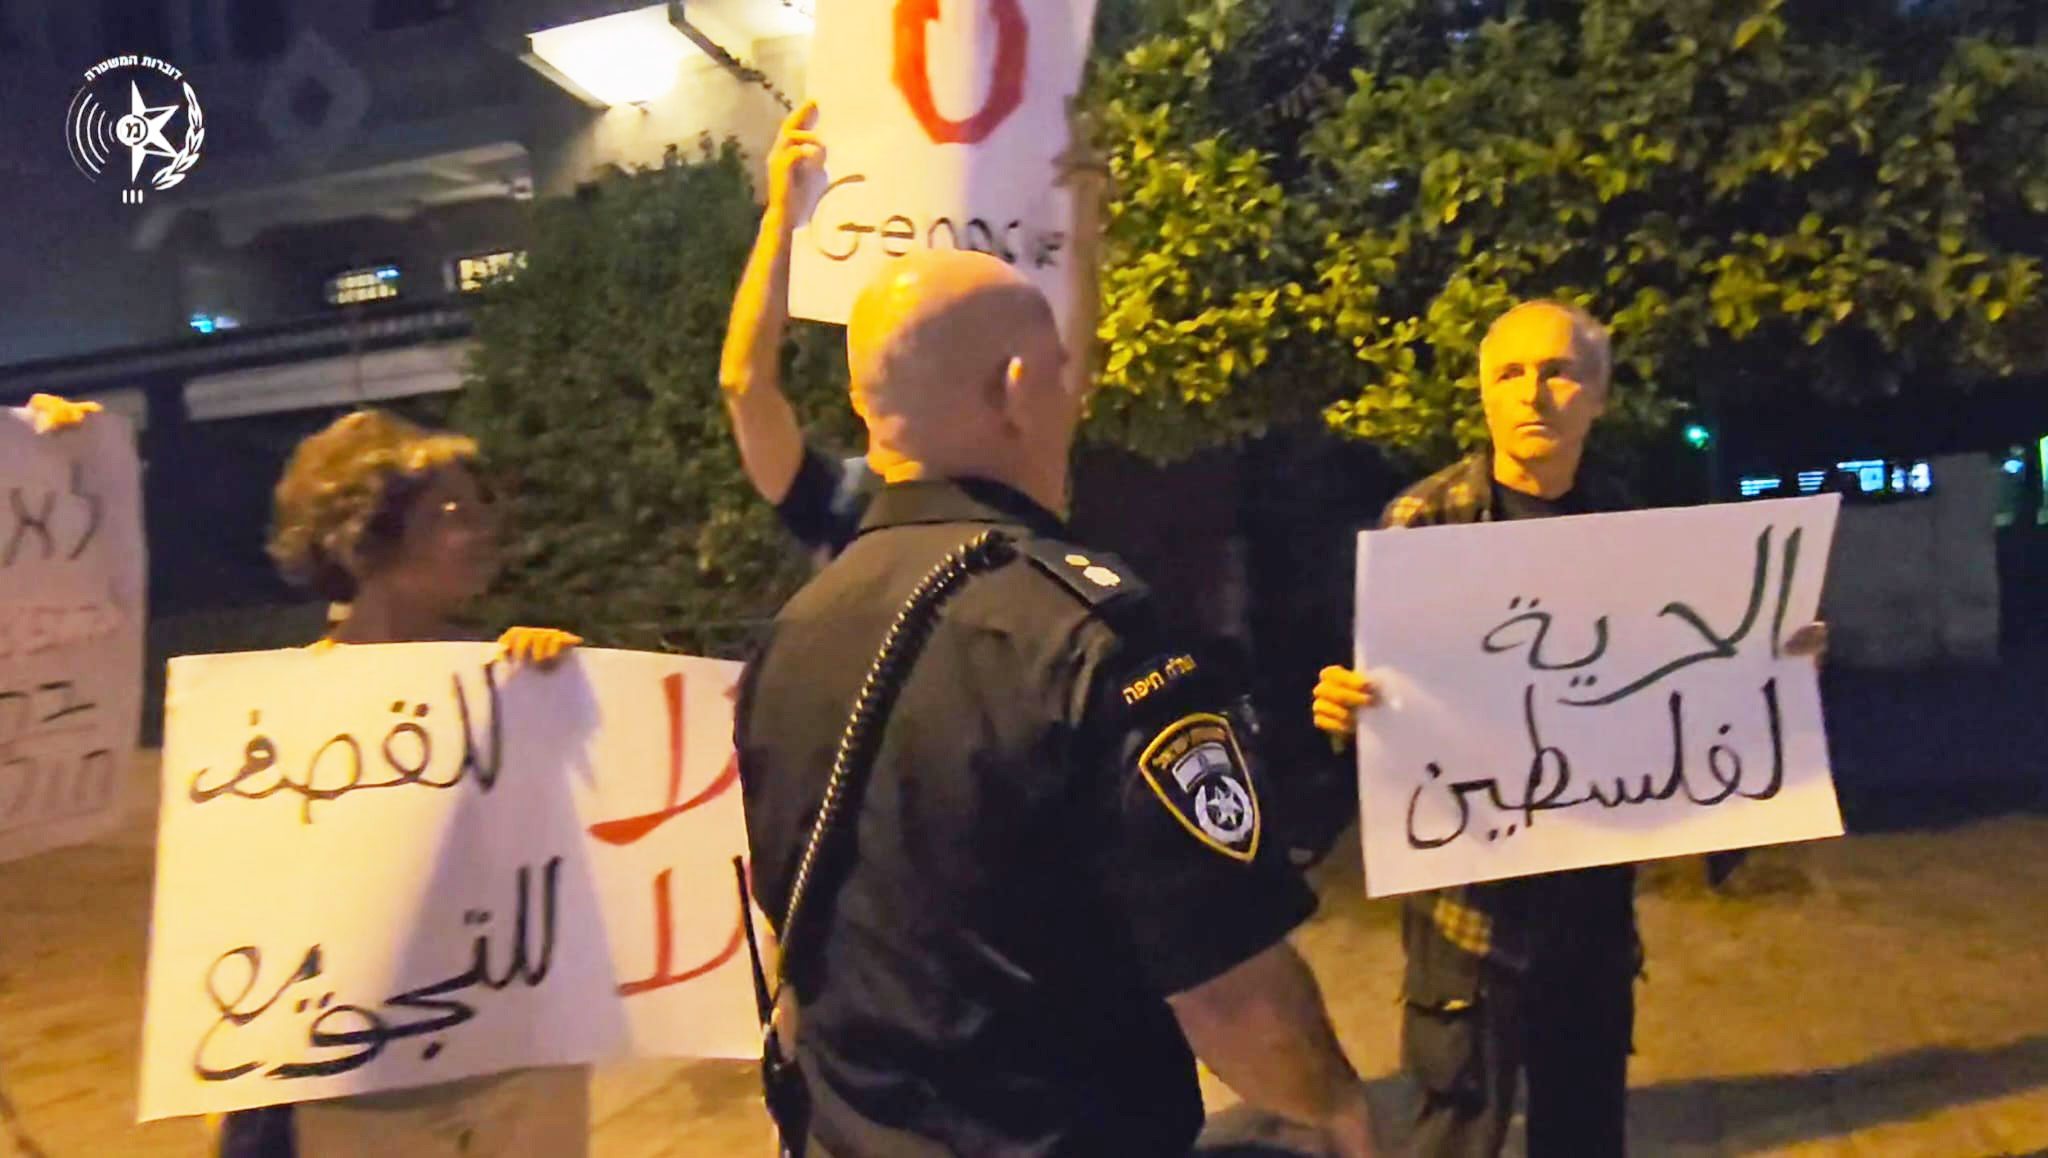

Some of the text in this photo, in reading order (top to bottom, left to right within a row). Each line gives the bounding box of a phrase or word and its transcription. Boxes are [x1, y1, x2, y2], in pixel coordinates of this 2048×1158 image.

[1122, 671, 1165, 705] חיפה
[1480, 524, 1803, 706] الحرية
[189, 662, 504, 825] للقصف
[1405, 677, 1783, 850] لفلسطين
[193, 856, 564, 1080] للتجويع
